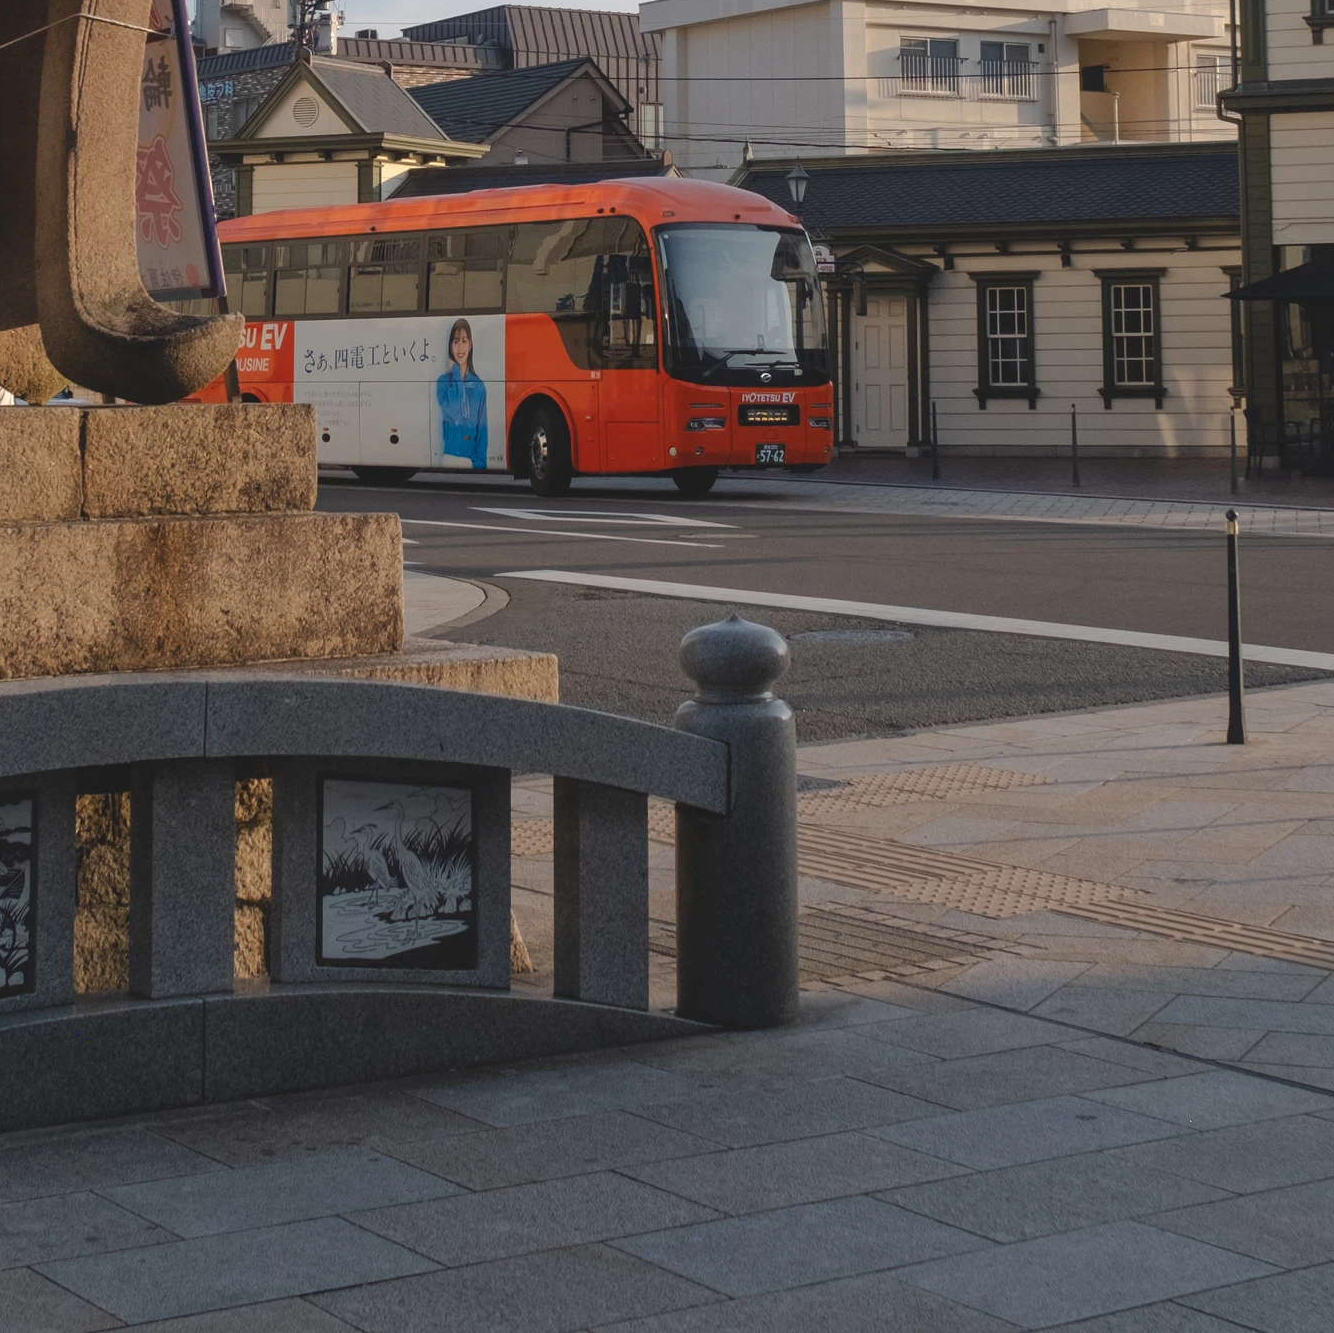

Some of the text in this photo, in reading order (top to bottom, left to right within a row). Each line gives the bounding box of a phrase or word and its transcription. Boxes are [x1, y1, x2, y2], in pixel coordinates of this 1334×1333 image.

[260, 323, 288, 350] EV
[304, 338, 437, 374] さあ、四電工といくよ。
[742, 392, 795, 403] IYOTETSU EV
